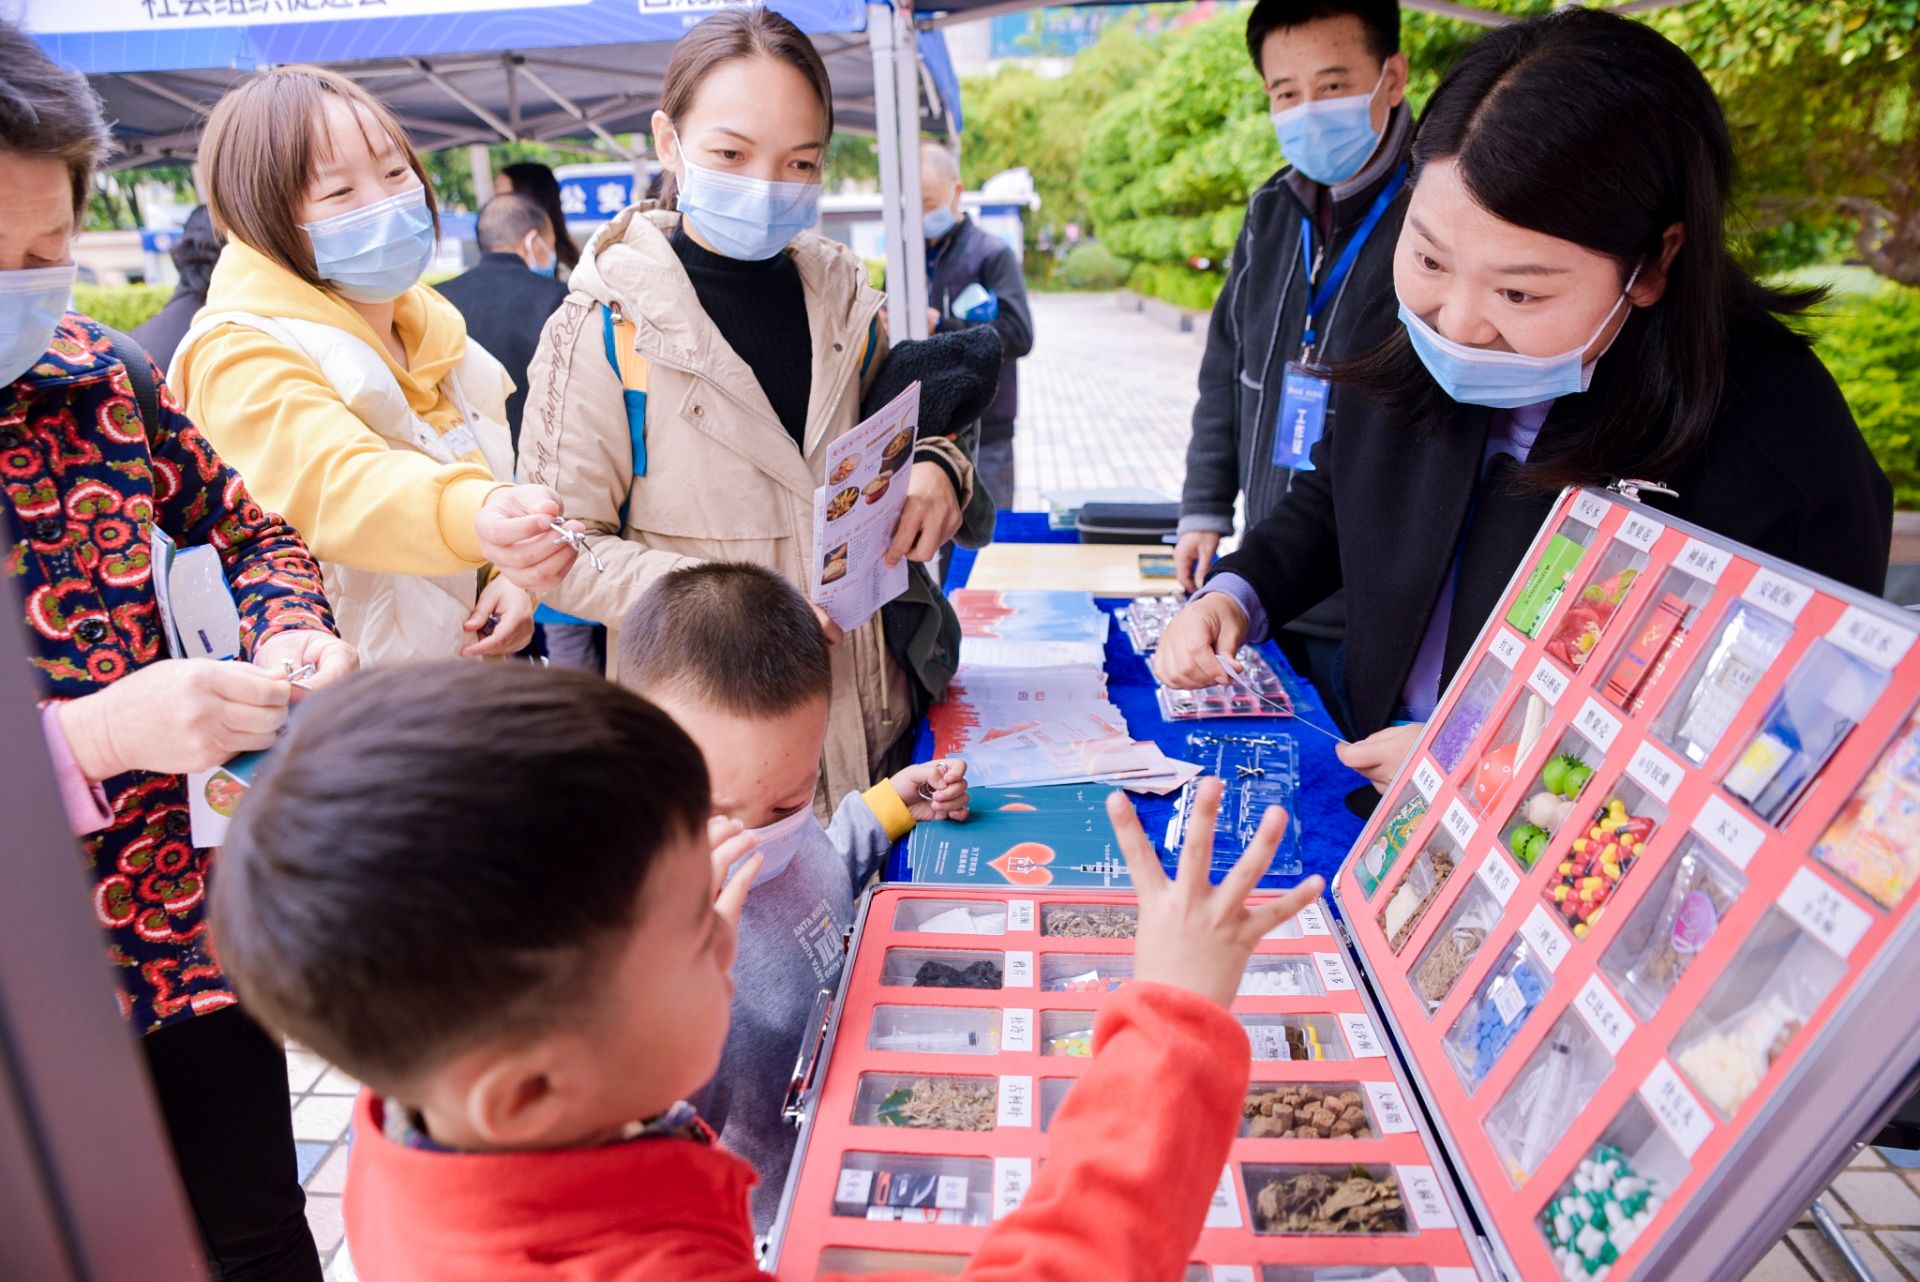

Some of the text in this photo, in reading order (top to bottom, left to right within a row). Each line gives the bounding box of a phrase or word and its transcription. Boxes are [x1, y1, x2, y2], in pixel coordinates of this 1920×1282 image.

[1715, 818, 1740, 844] K2
[793, 917, 813, 938] ANTA
[799, 936, 816, 960] KIDS
[1009, 1016, 1025, 1043] 杜冷丁
[1007, 1084, 1025, 1118] 古柯叶
